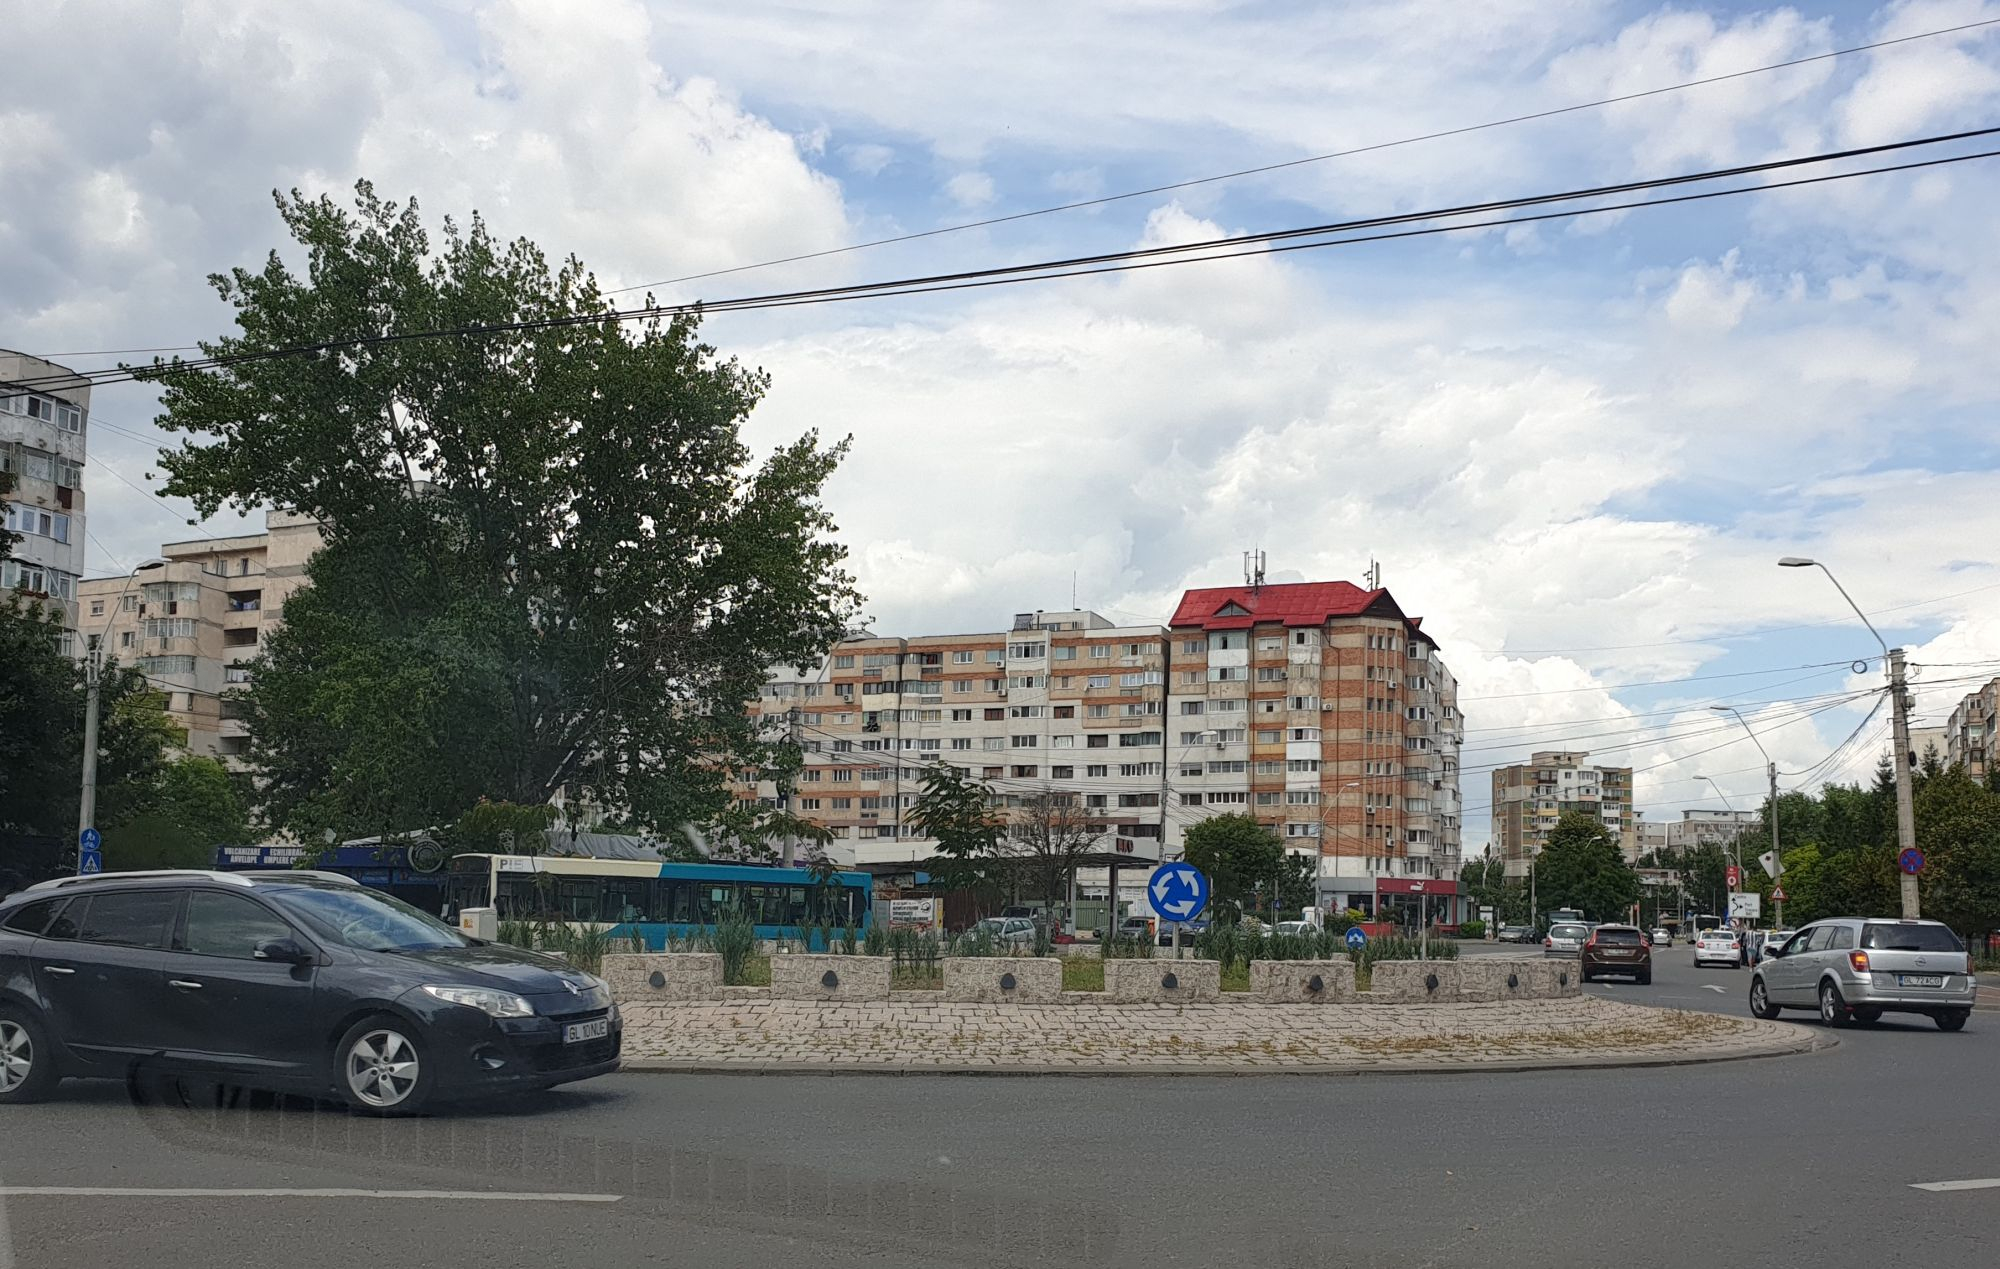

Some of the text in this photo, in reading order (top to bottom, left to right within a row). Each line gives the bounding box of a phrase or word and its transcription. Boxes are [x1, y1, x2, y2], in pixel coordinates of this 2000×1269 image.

[224, 847, 261, 856] VULCANIZARE
[230, 855, 258, 864] ANVELOPE
[570, 1026, 581, 1040] GL
